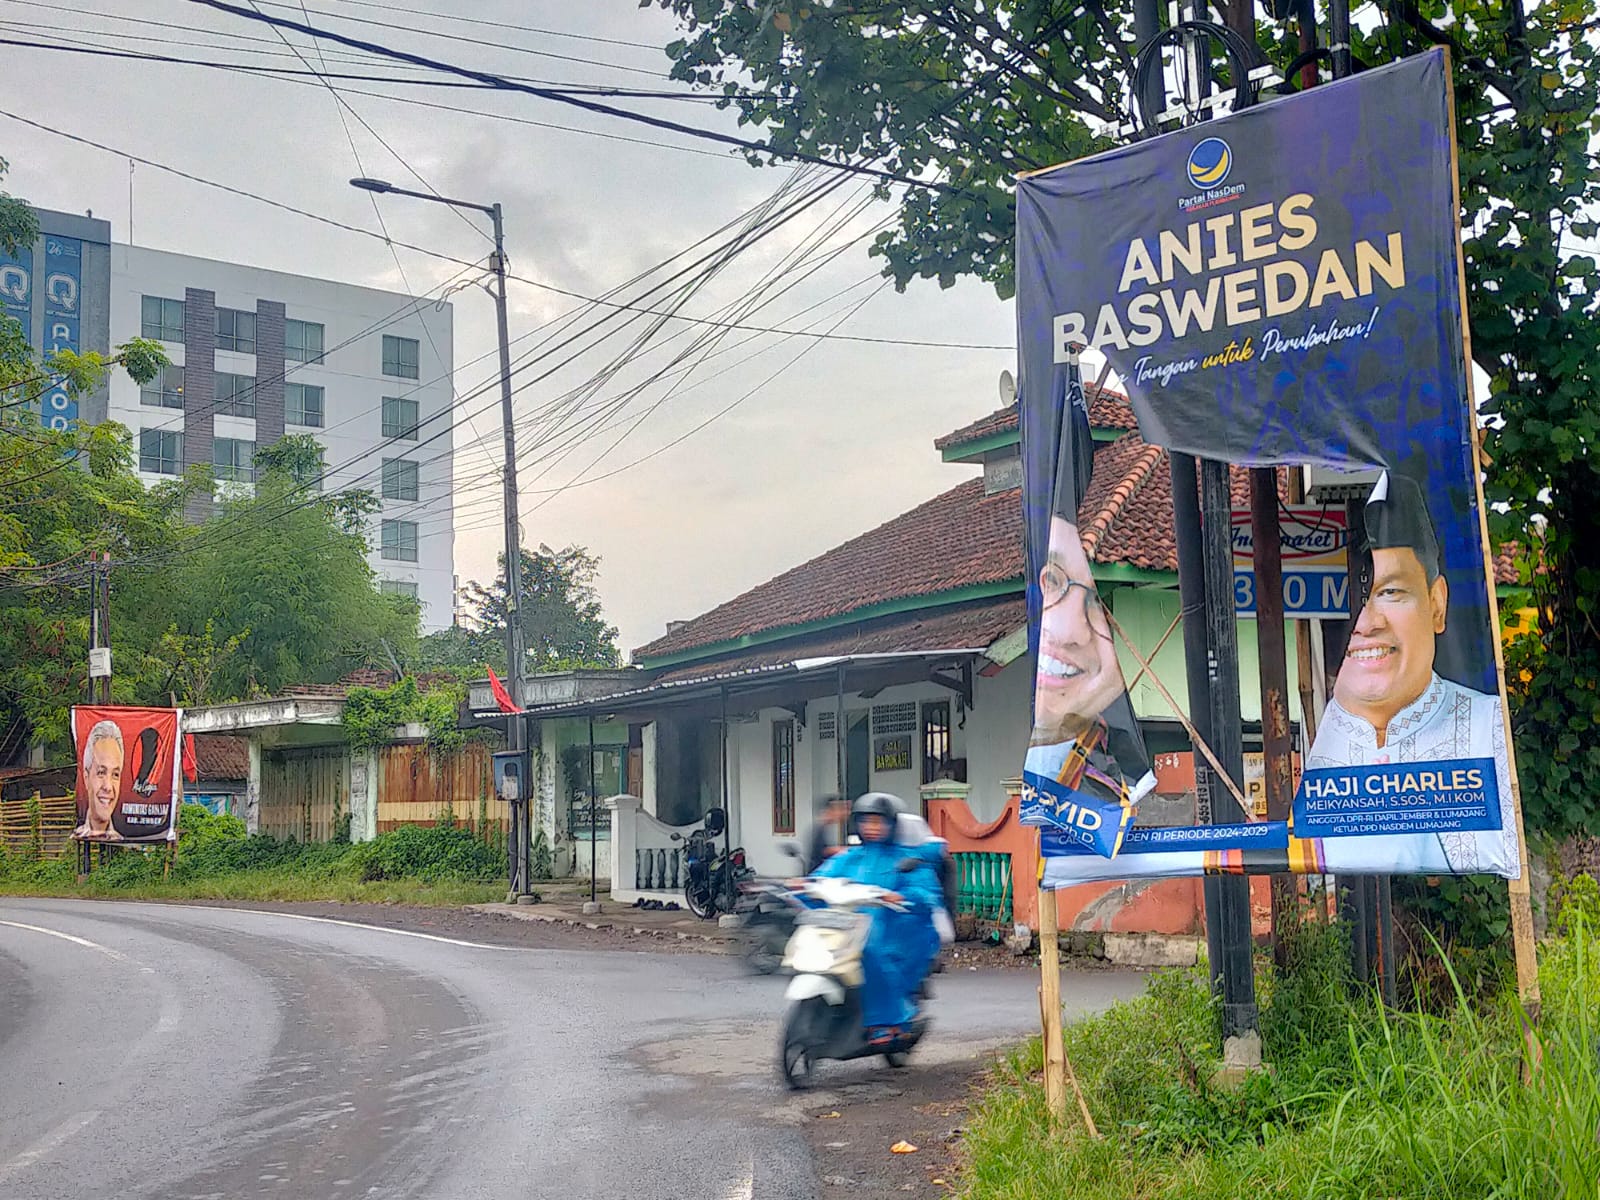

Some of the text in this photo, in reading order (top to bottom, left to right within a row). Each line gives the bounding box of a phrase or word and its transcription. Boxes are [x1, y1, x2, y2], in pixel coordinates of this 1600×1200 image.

[1178, 184, 1245, 208] Partai NasDem
[1118, 193, 1318, 293] ANIES
[1053, 232, 1405, 364] BASWEDAN
[1134, 307, 1379, 387] Tangan untuk Perubahan!
[1322, 576, 1349, 608] M
[1304, 769, 1483, 798] HAJI CHARLES
[1306, 797, 1388, 810] MEIKYANSAH,
[1434, 792, 1485, 804] M.I.KOM
[1307, 815, 1345, 825] ANGGOTA
[1347, 814, 1374, 823] DPR-RI
[1375, 813, 1399, 822] DAPIL
[1400, 811, 1432, 821] JEMBER
[1441, 809, 1486, 818] LUMAJANG
[1333, 820, 1461, 833] KETUA DPD NASDEM LUMAJANG
[1163, 829, 1212, 840] PERIODE
[1213, 826, 1268, 838] 2024-2029
